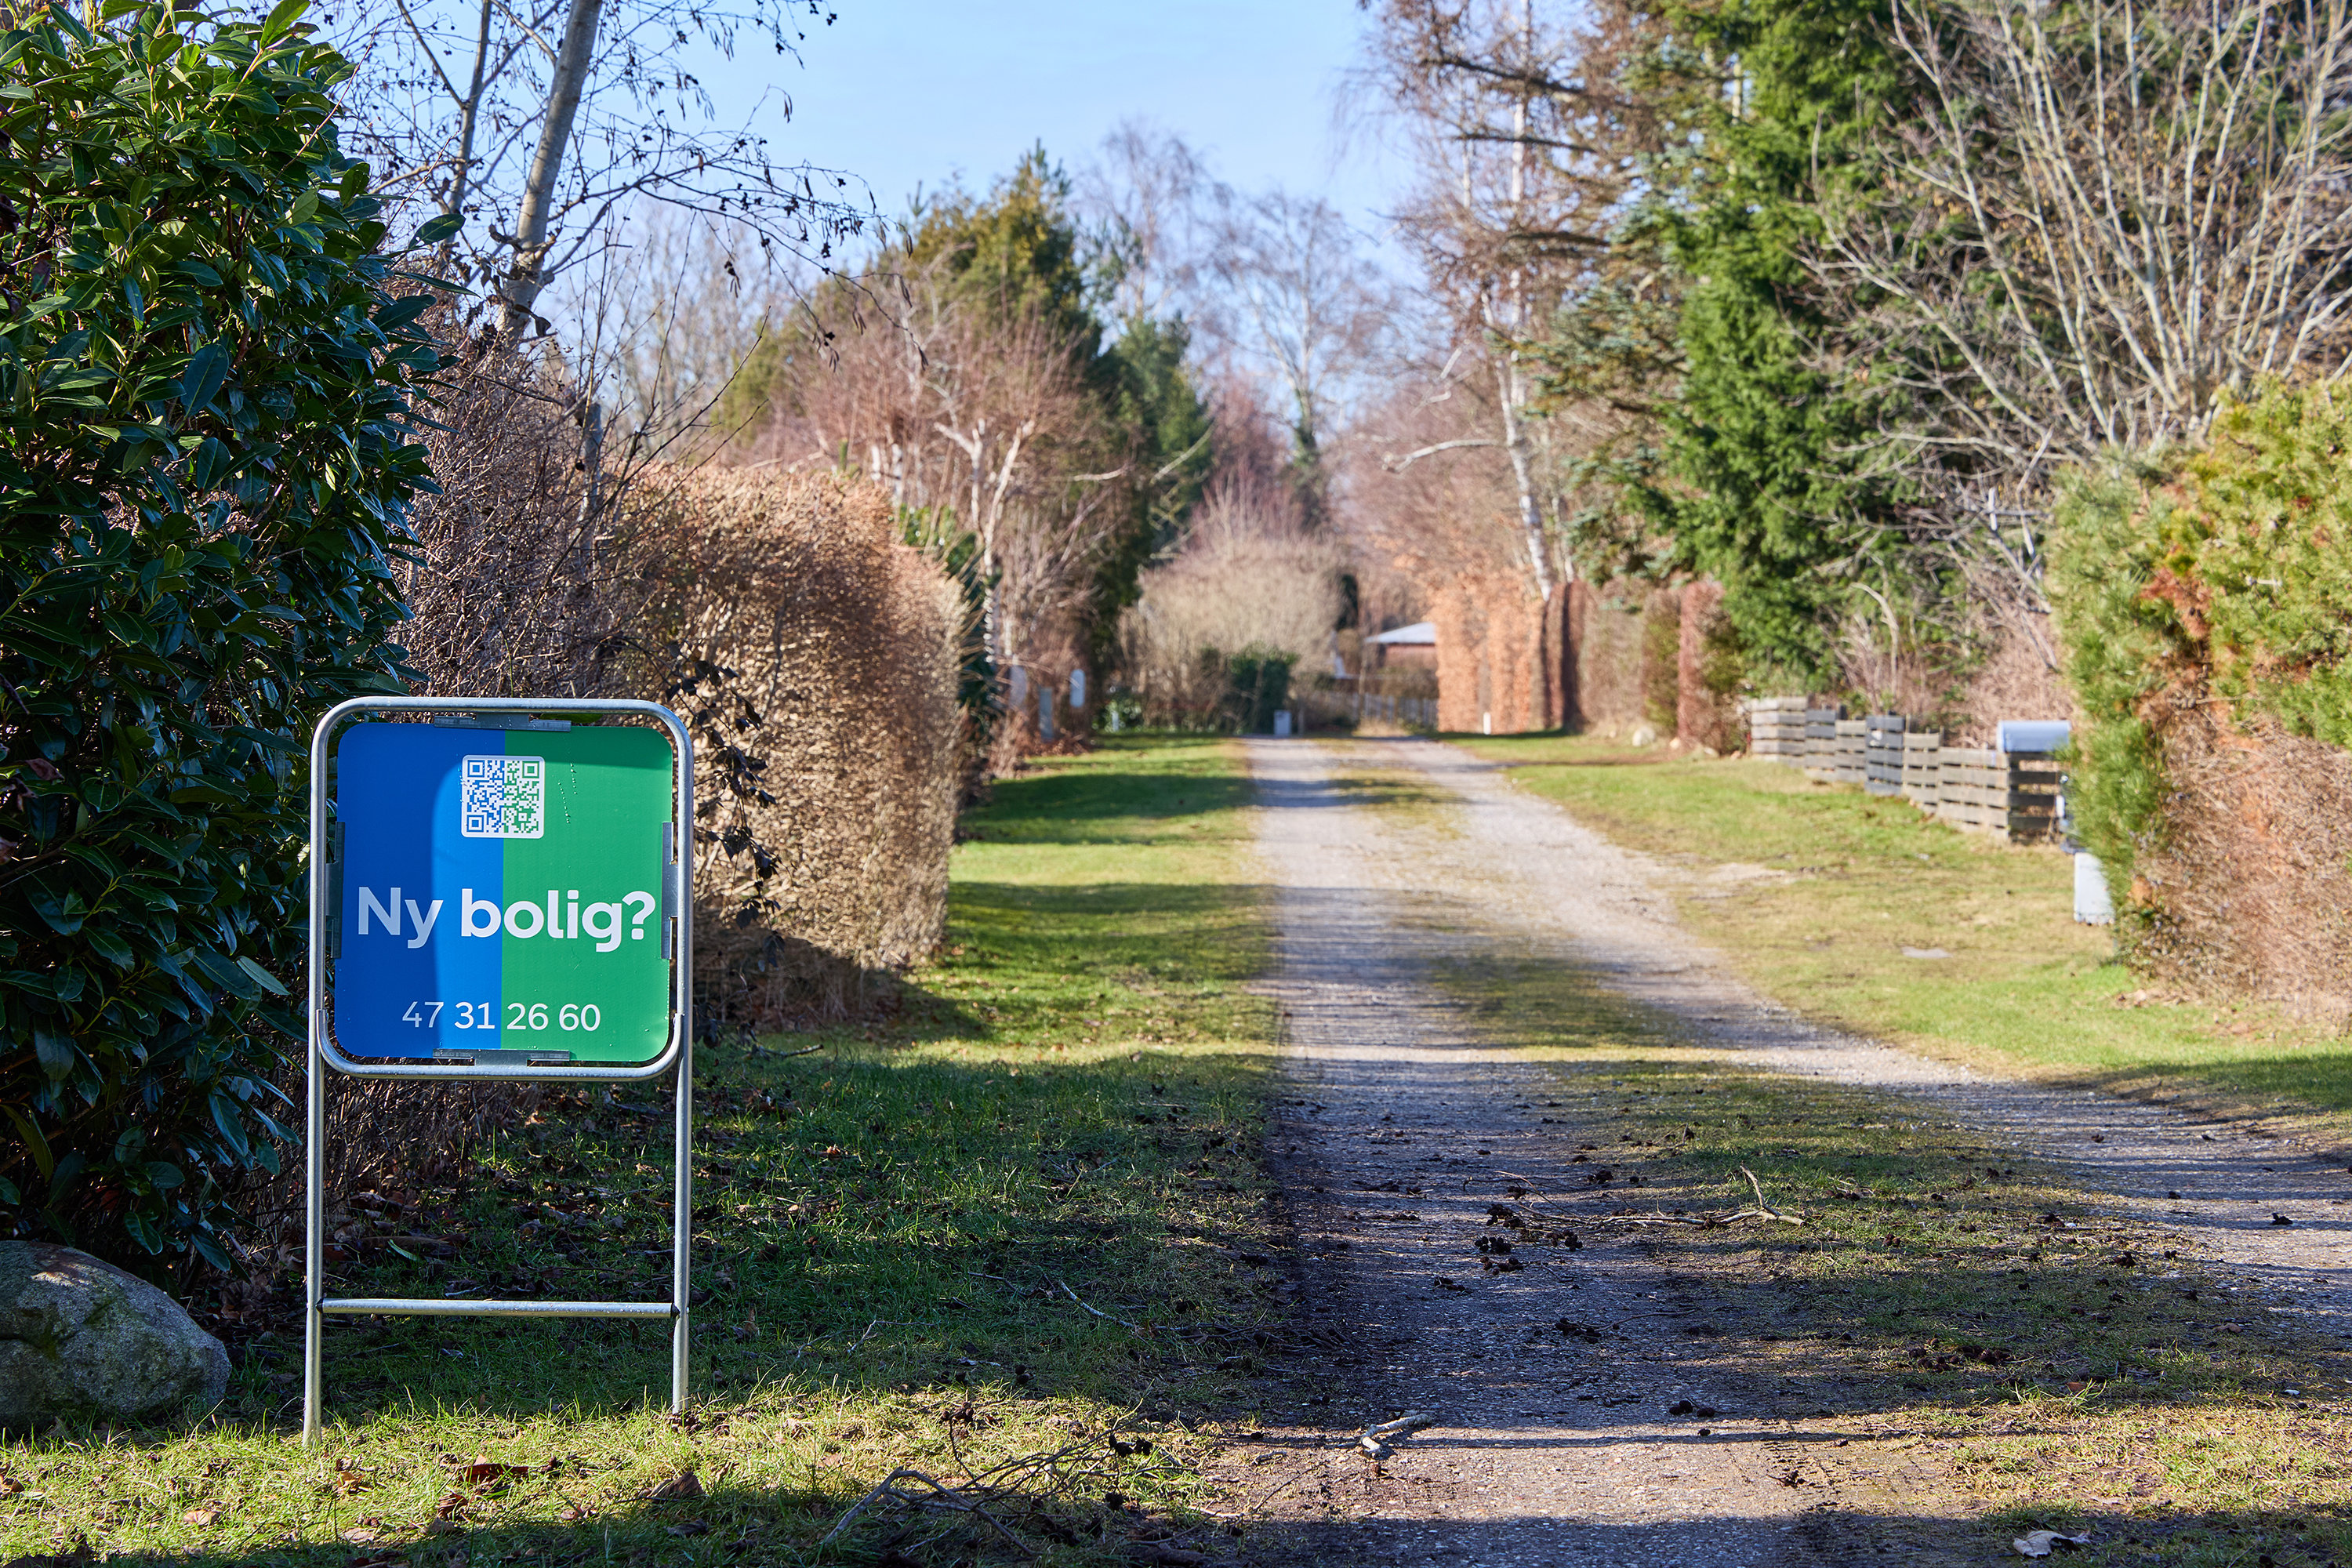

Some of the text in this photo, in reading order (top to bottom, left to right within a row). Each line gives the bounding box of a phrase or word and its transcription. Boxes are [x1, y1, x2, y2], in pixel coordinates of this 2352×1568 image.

[358, 886, 656, 953] Ny bolig?
[402, 1001, 601, 1032] 47 31 26 60
